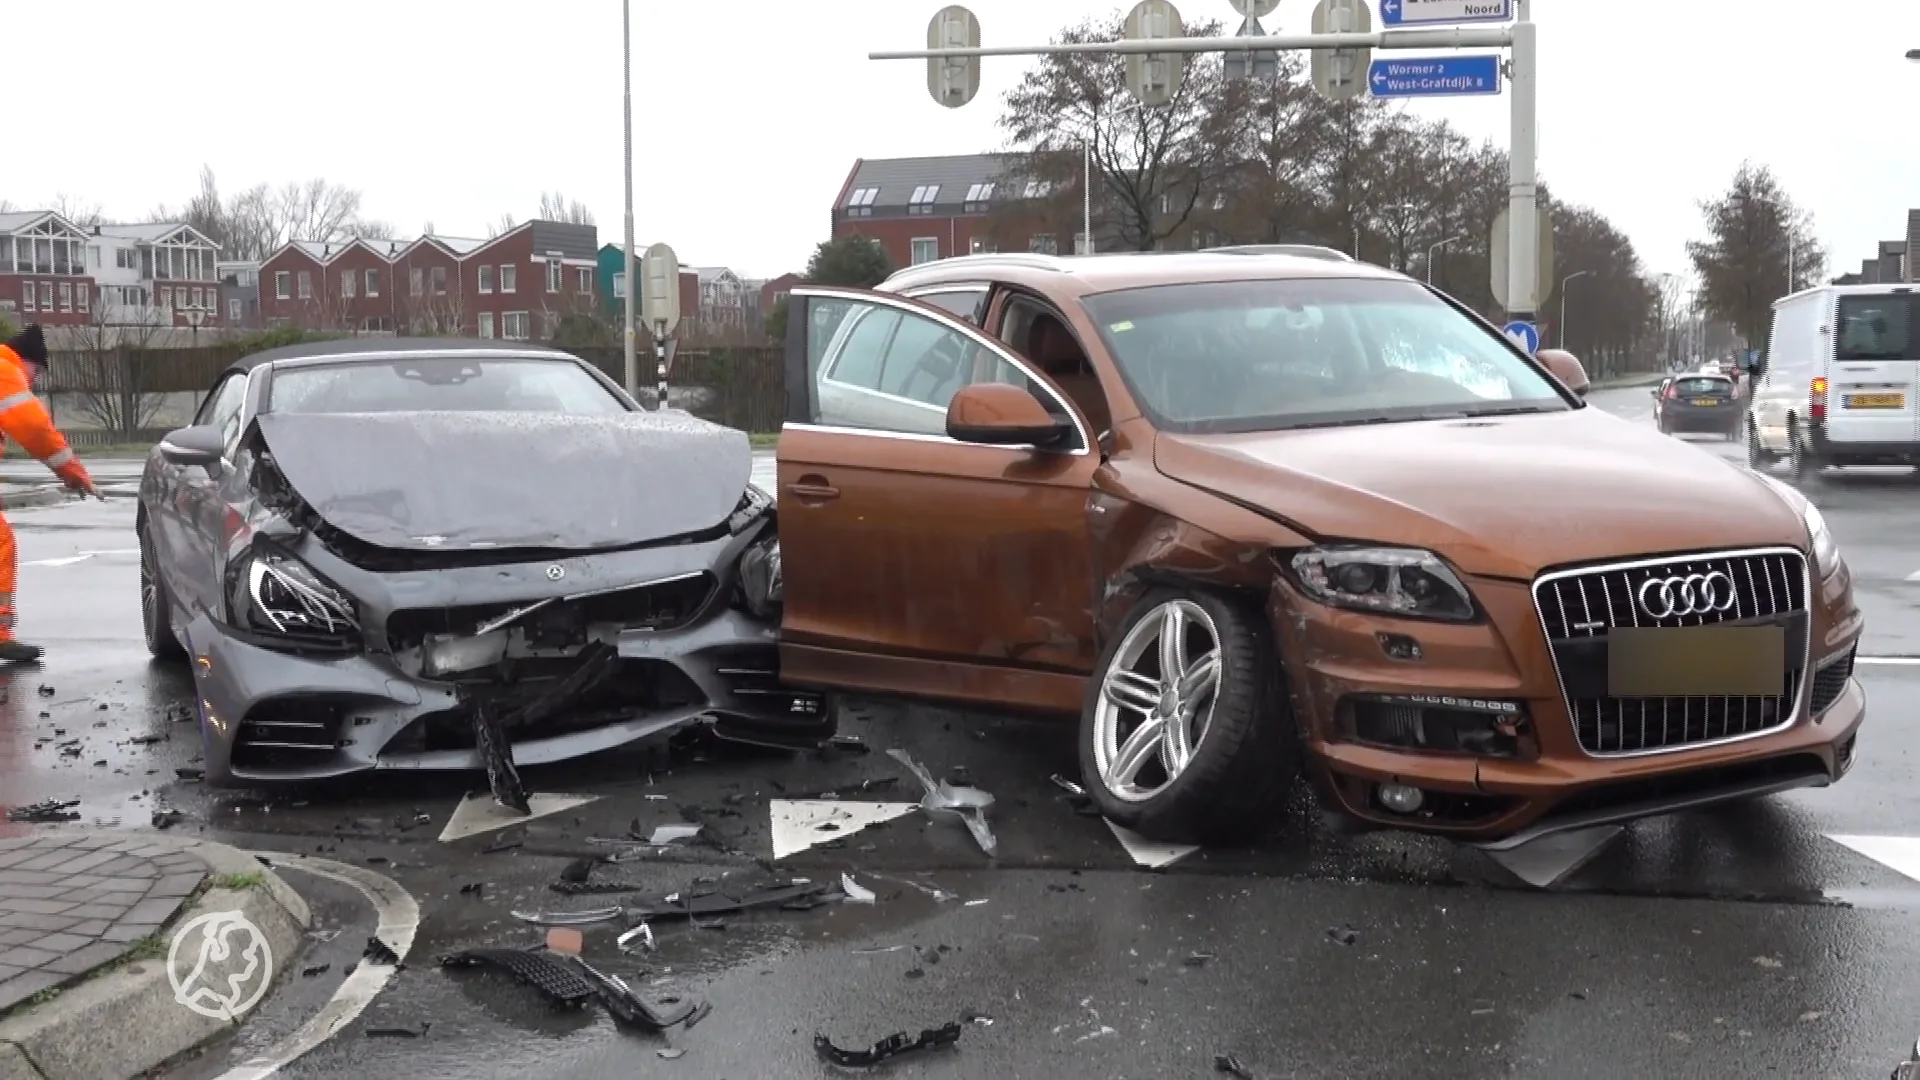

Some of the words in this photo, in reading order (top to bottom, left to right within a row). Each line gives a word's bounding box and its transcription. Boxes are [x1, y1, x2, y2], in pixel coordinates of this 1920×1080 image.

[1464, 4, 1501, 15] Noord
[1388, 64, 1435, 76] Wormer
[1438, 64, 1445, 74] 2
[1387, 76, 1472, 90] West-Graftdijk
